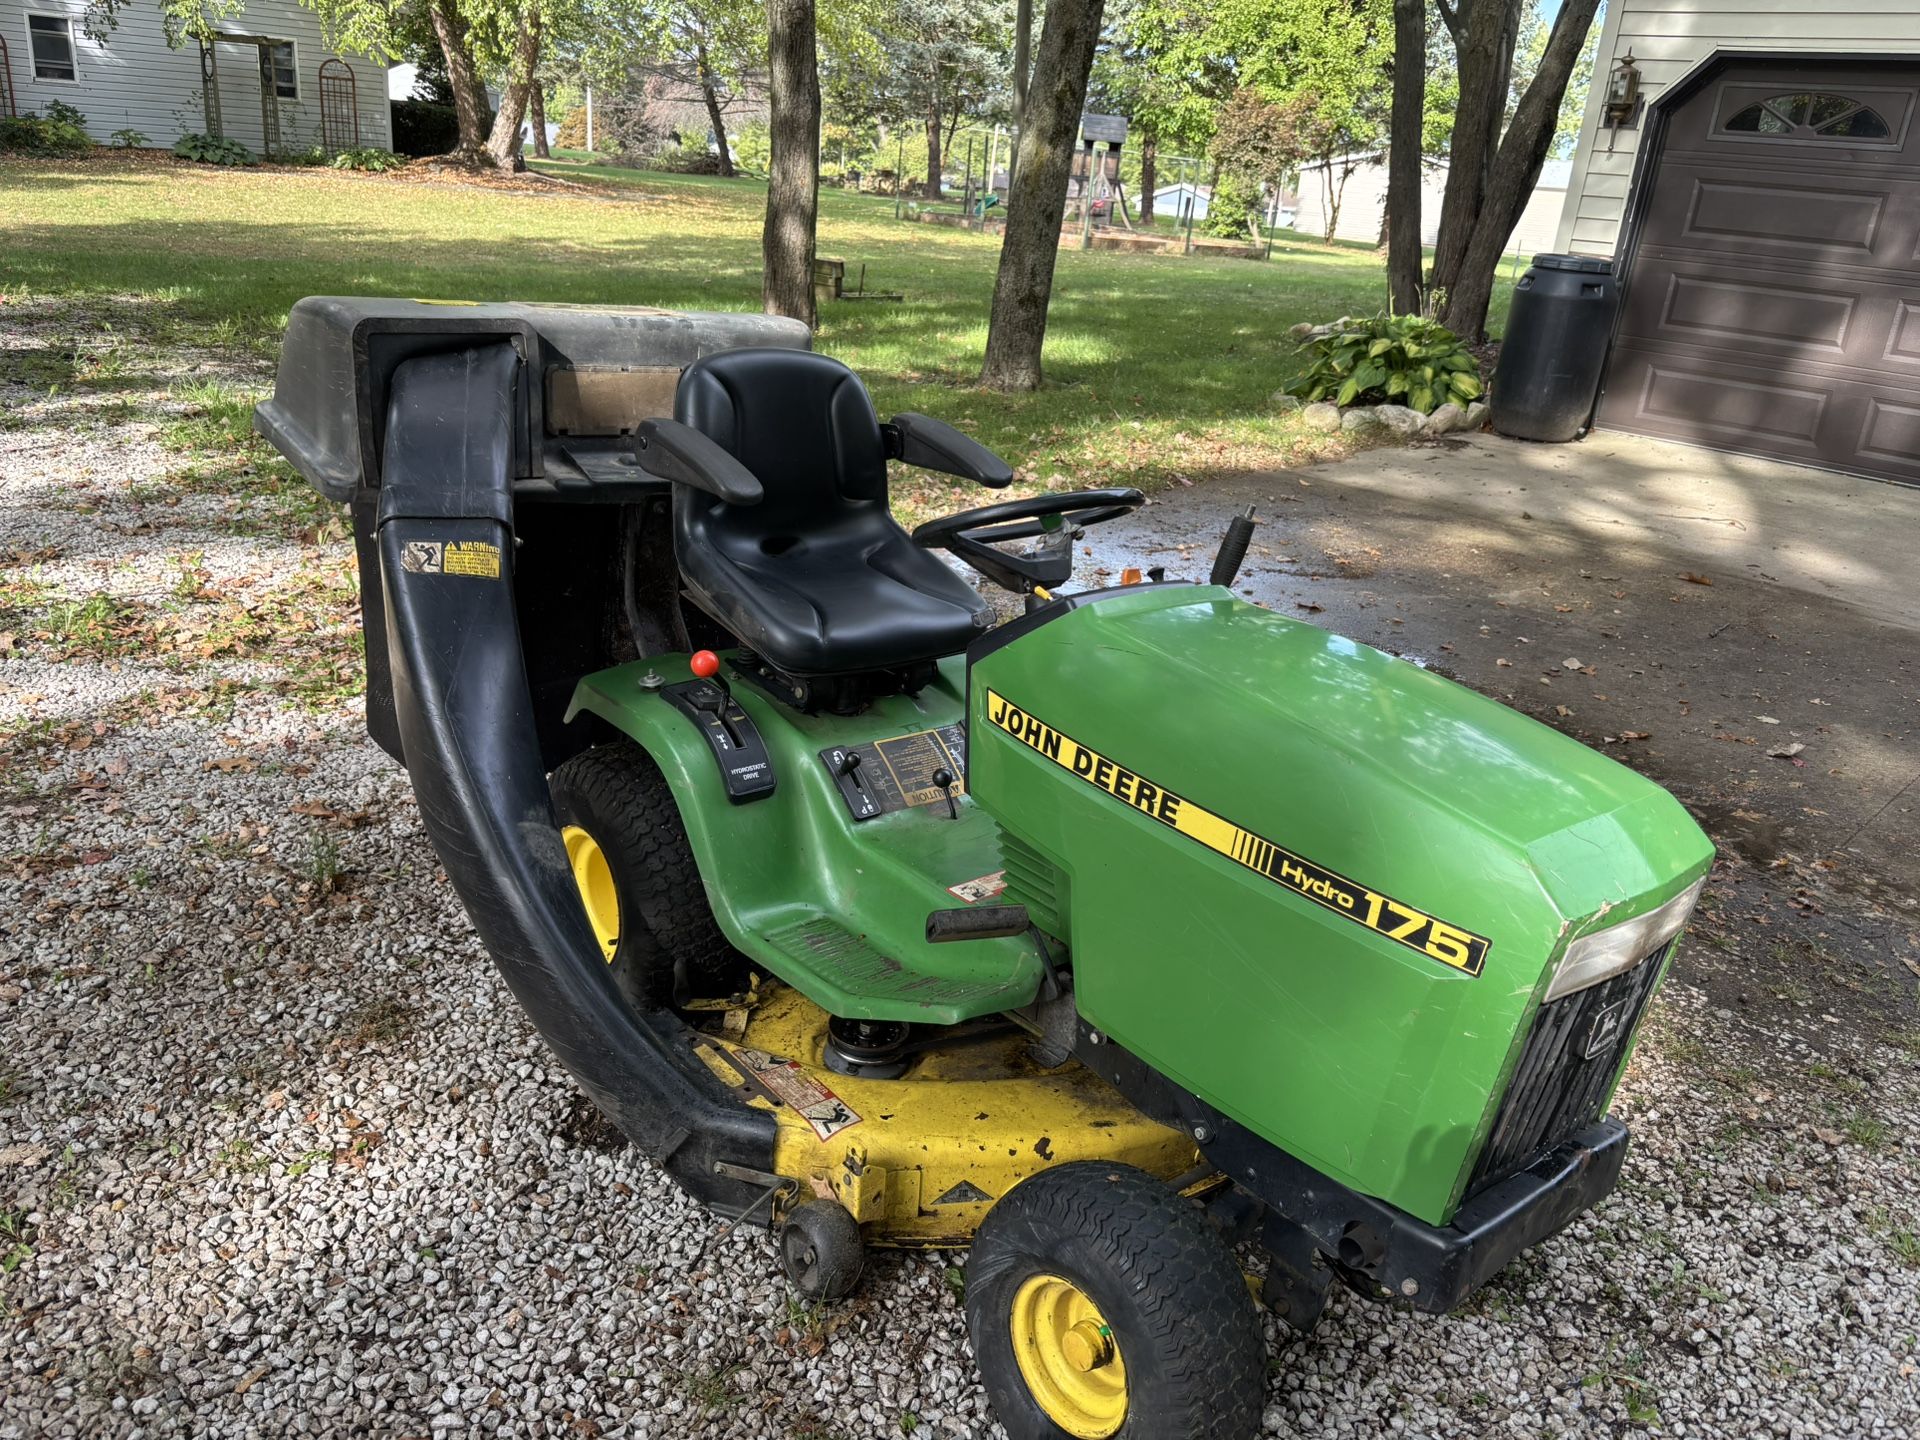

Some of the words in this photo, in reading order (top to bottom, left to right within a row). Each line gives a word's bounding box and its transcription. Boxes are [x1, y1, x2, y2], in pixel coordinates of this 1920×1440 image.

[459, 541, 500, 553] WARNING
[731, 762, 767, 775] HYDROSTATIC
[743, 771, 760, 780] DRIVE
[995, 701, 1062, 760] JOHN
[1073, 746, 1181, 826] DEERE
[1281, 860, 1354, 909] Hydro
[1364, 891, 1472, 967] 175
